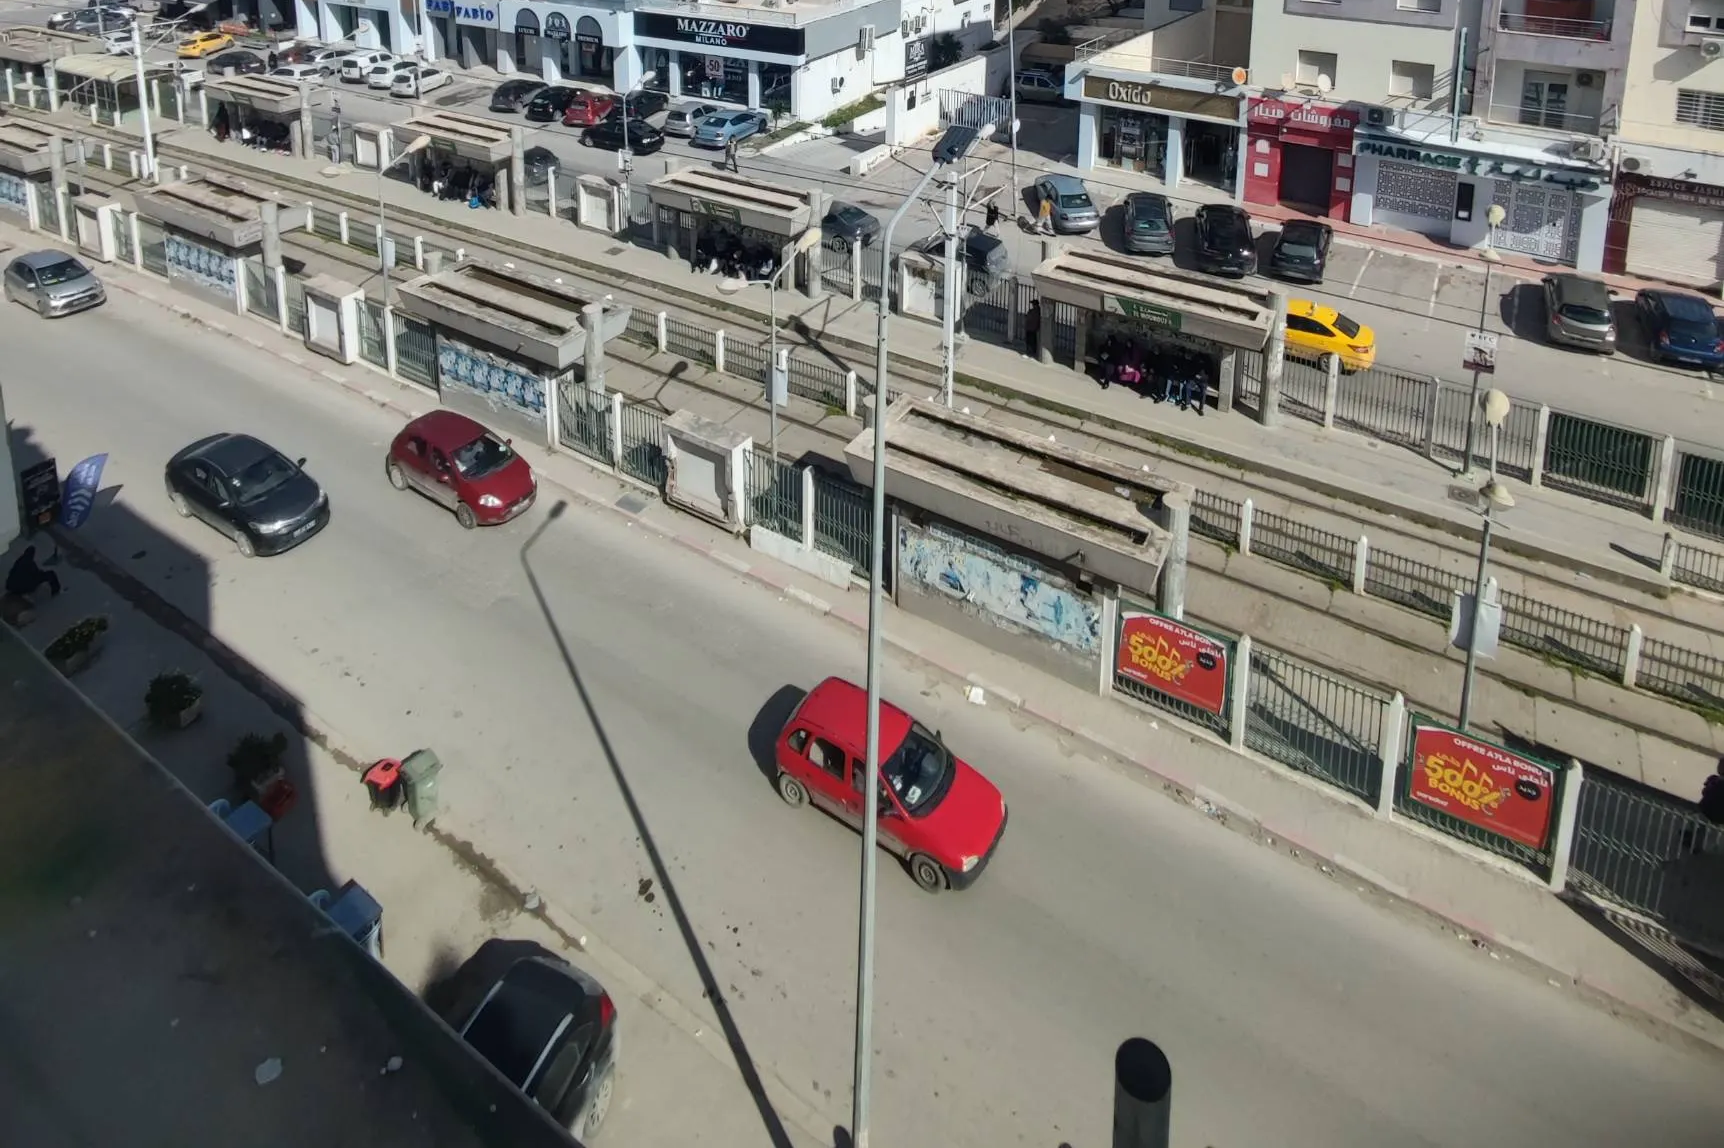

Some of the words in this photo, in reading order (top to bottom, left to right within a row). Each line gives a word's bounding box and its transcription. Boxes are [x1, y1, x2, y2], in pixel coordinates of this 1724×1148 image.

[456, 5, 494, 21] FABIO
[677, 18, 747, 38] MAZZARO
[695, 36, 728, 46] MILANO
[1109, 82, 1152, 104] Oxido
[1356, 142, 1462, 168] PHARMACIE
[1650, 179, 1686, 191] ESPACE
[1149, 618, 1174, 632] OFFRE
[1132, 654, 1172, 681] BONUS
[1453, 738, 1485, 756] OFFRE
[1428, 778, 1481, 811] BONUS
